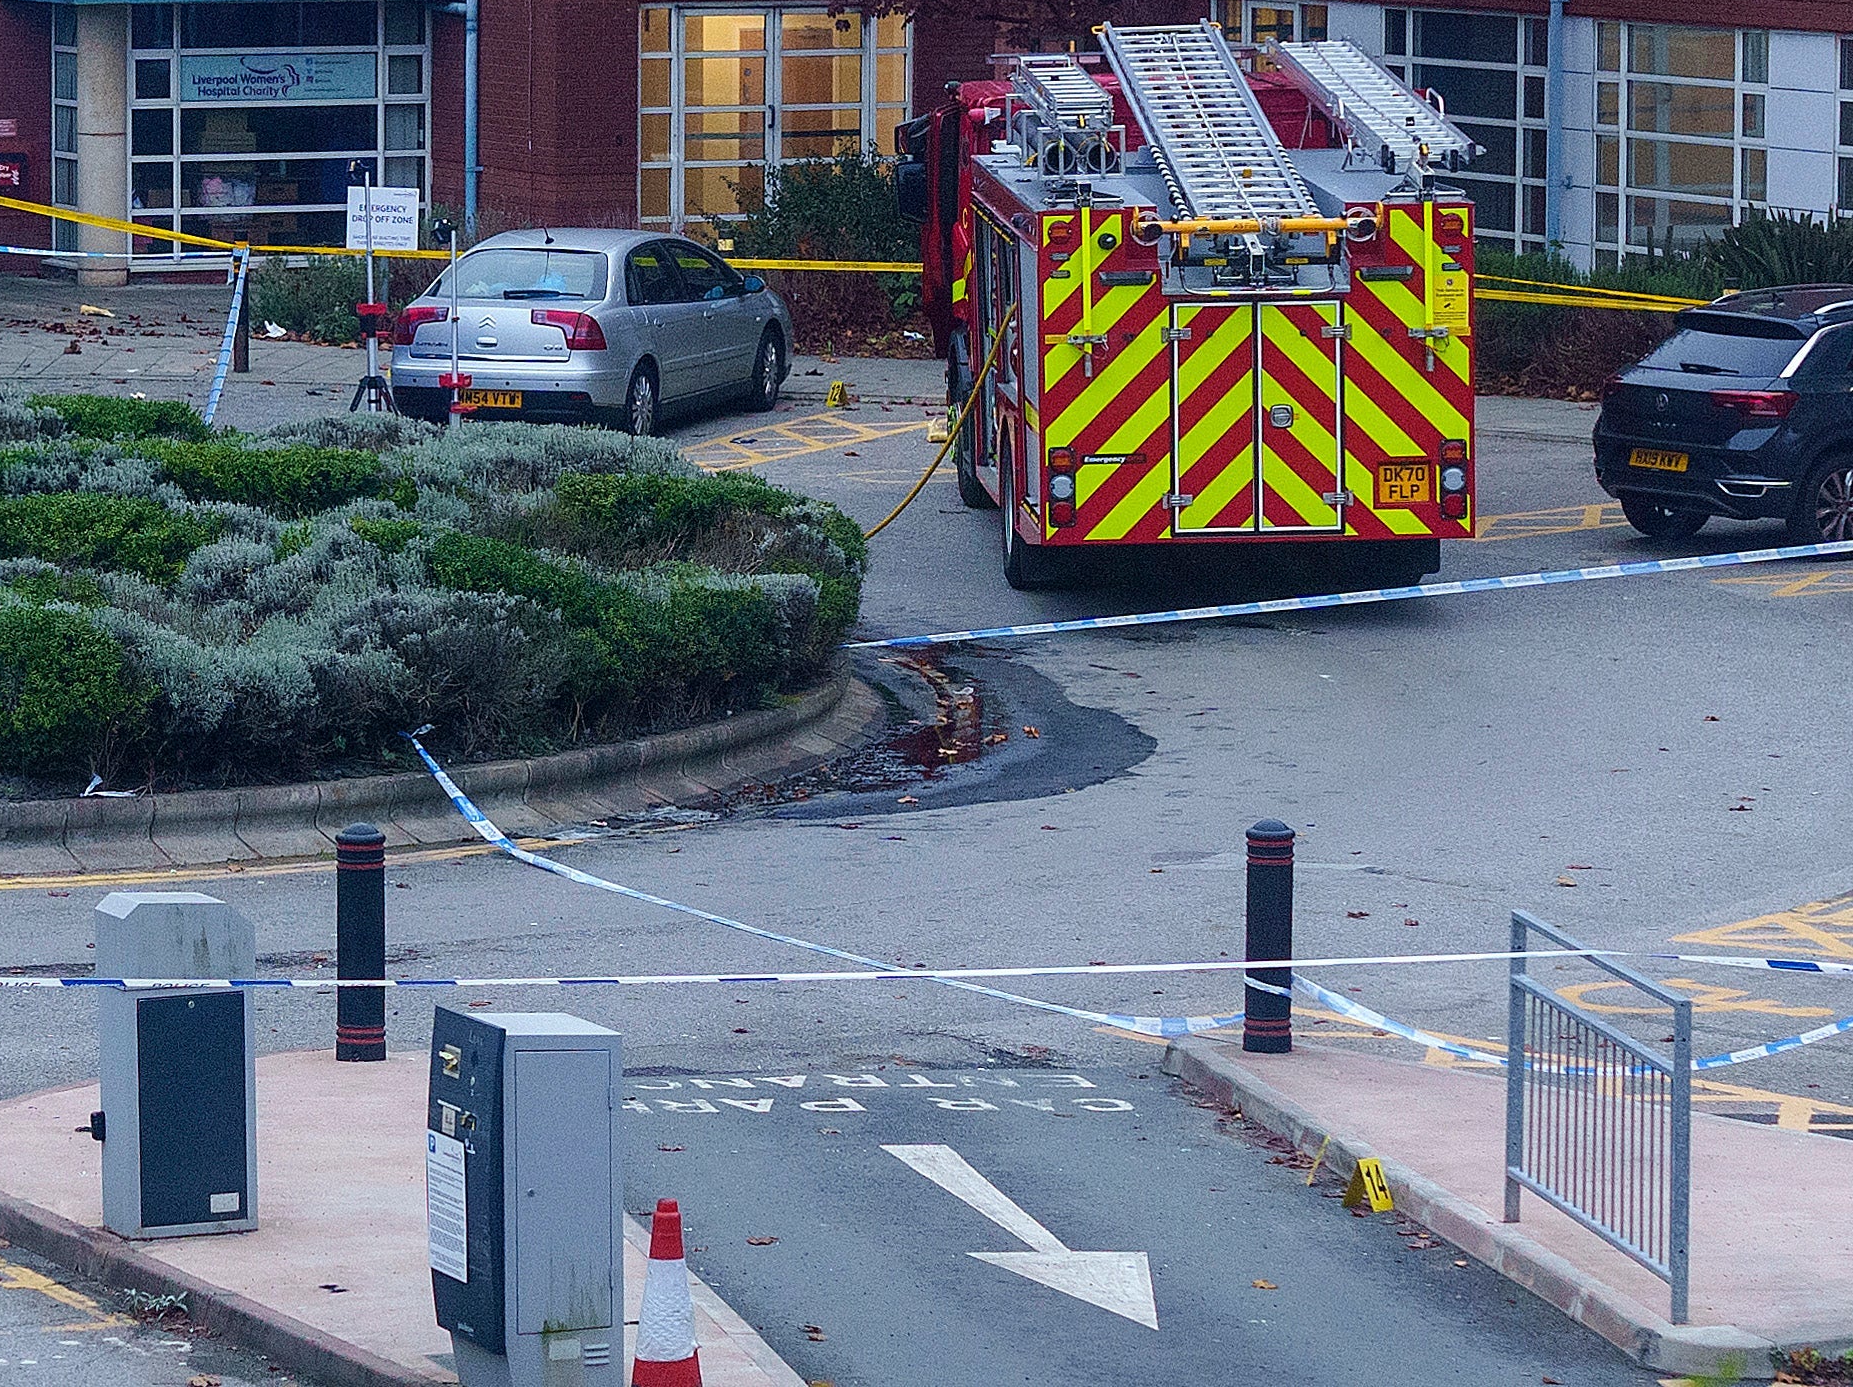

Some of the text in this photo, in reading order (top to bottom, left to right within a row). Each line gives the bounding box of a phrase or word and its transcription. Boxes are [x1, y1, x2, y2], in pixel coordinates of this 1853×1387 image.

[192, 73, 285, 86] Liverpool Women's
[198, 86, 278, 98] Hospital Charity
[359, 204, 407, 213] EERGENCY
[375, 215, 390, 223] OFF
[392, 216, 413, 224] ZONE
[1084, 455, 1126, 464] Emergency
[1383, 466, 1425, 482] DK70
[1388, 484, 1420, 499] FLP
[633, 1074, 1097, 1090] ENTRANC
[926, 1097, 1135, 1112] CAR
[1365, 1163, 1390, 1202] 14
